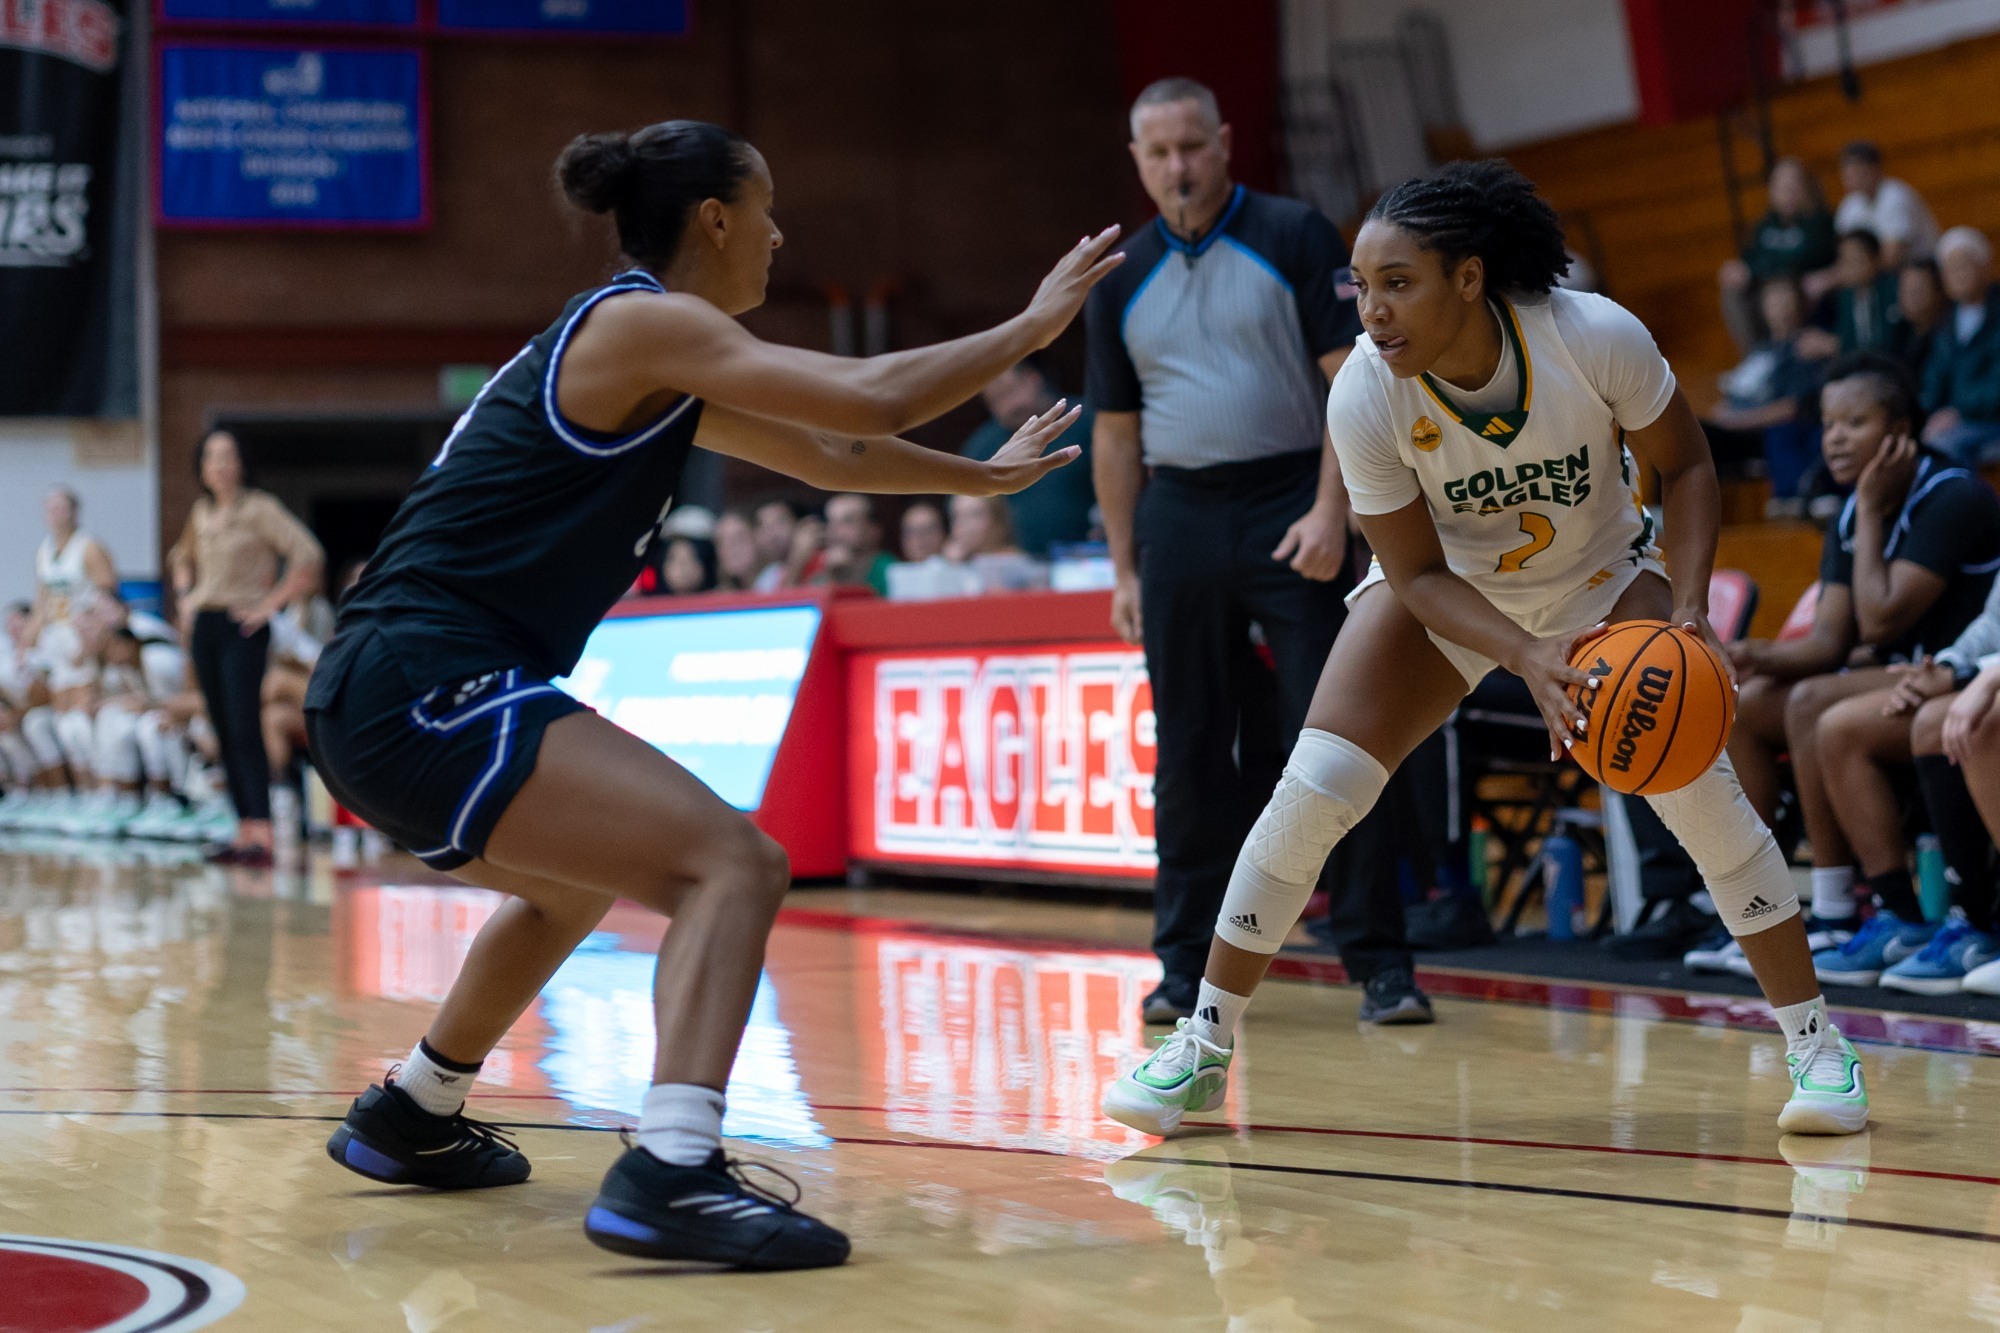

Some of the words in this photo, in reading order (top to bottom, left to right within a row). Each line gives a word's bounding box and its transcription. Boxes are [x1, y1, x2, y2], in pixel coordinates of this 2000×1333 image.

[1443, 443, 1591, 503] GOLDEN
[1451, 472, 1592, 517] EAGLES
[1493, 511, 1557, 573] 2
[1609, 665, 1674, 773] Wilson
[1229, 916, 1262, 935] adidas
[1741, 903, 1778, 919] adidas
